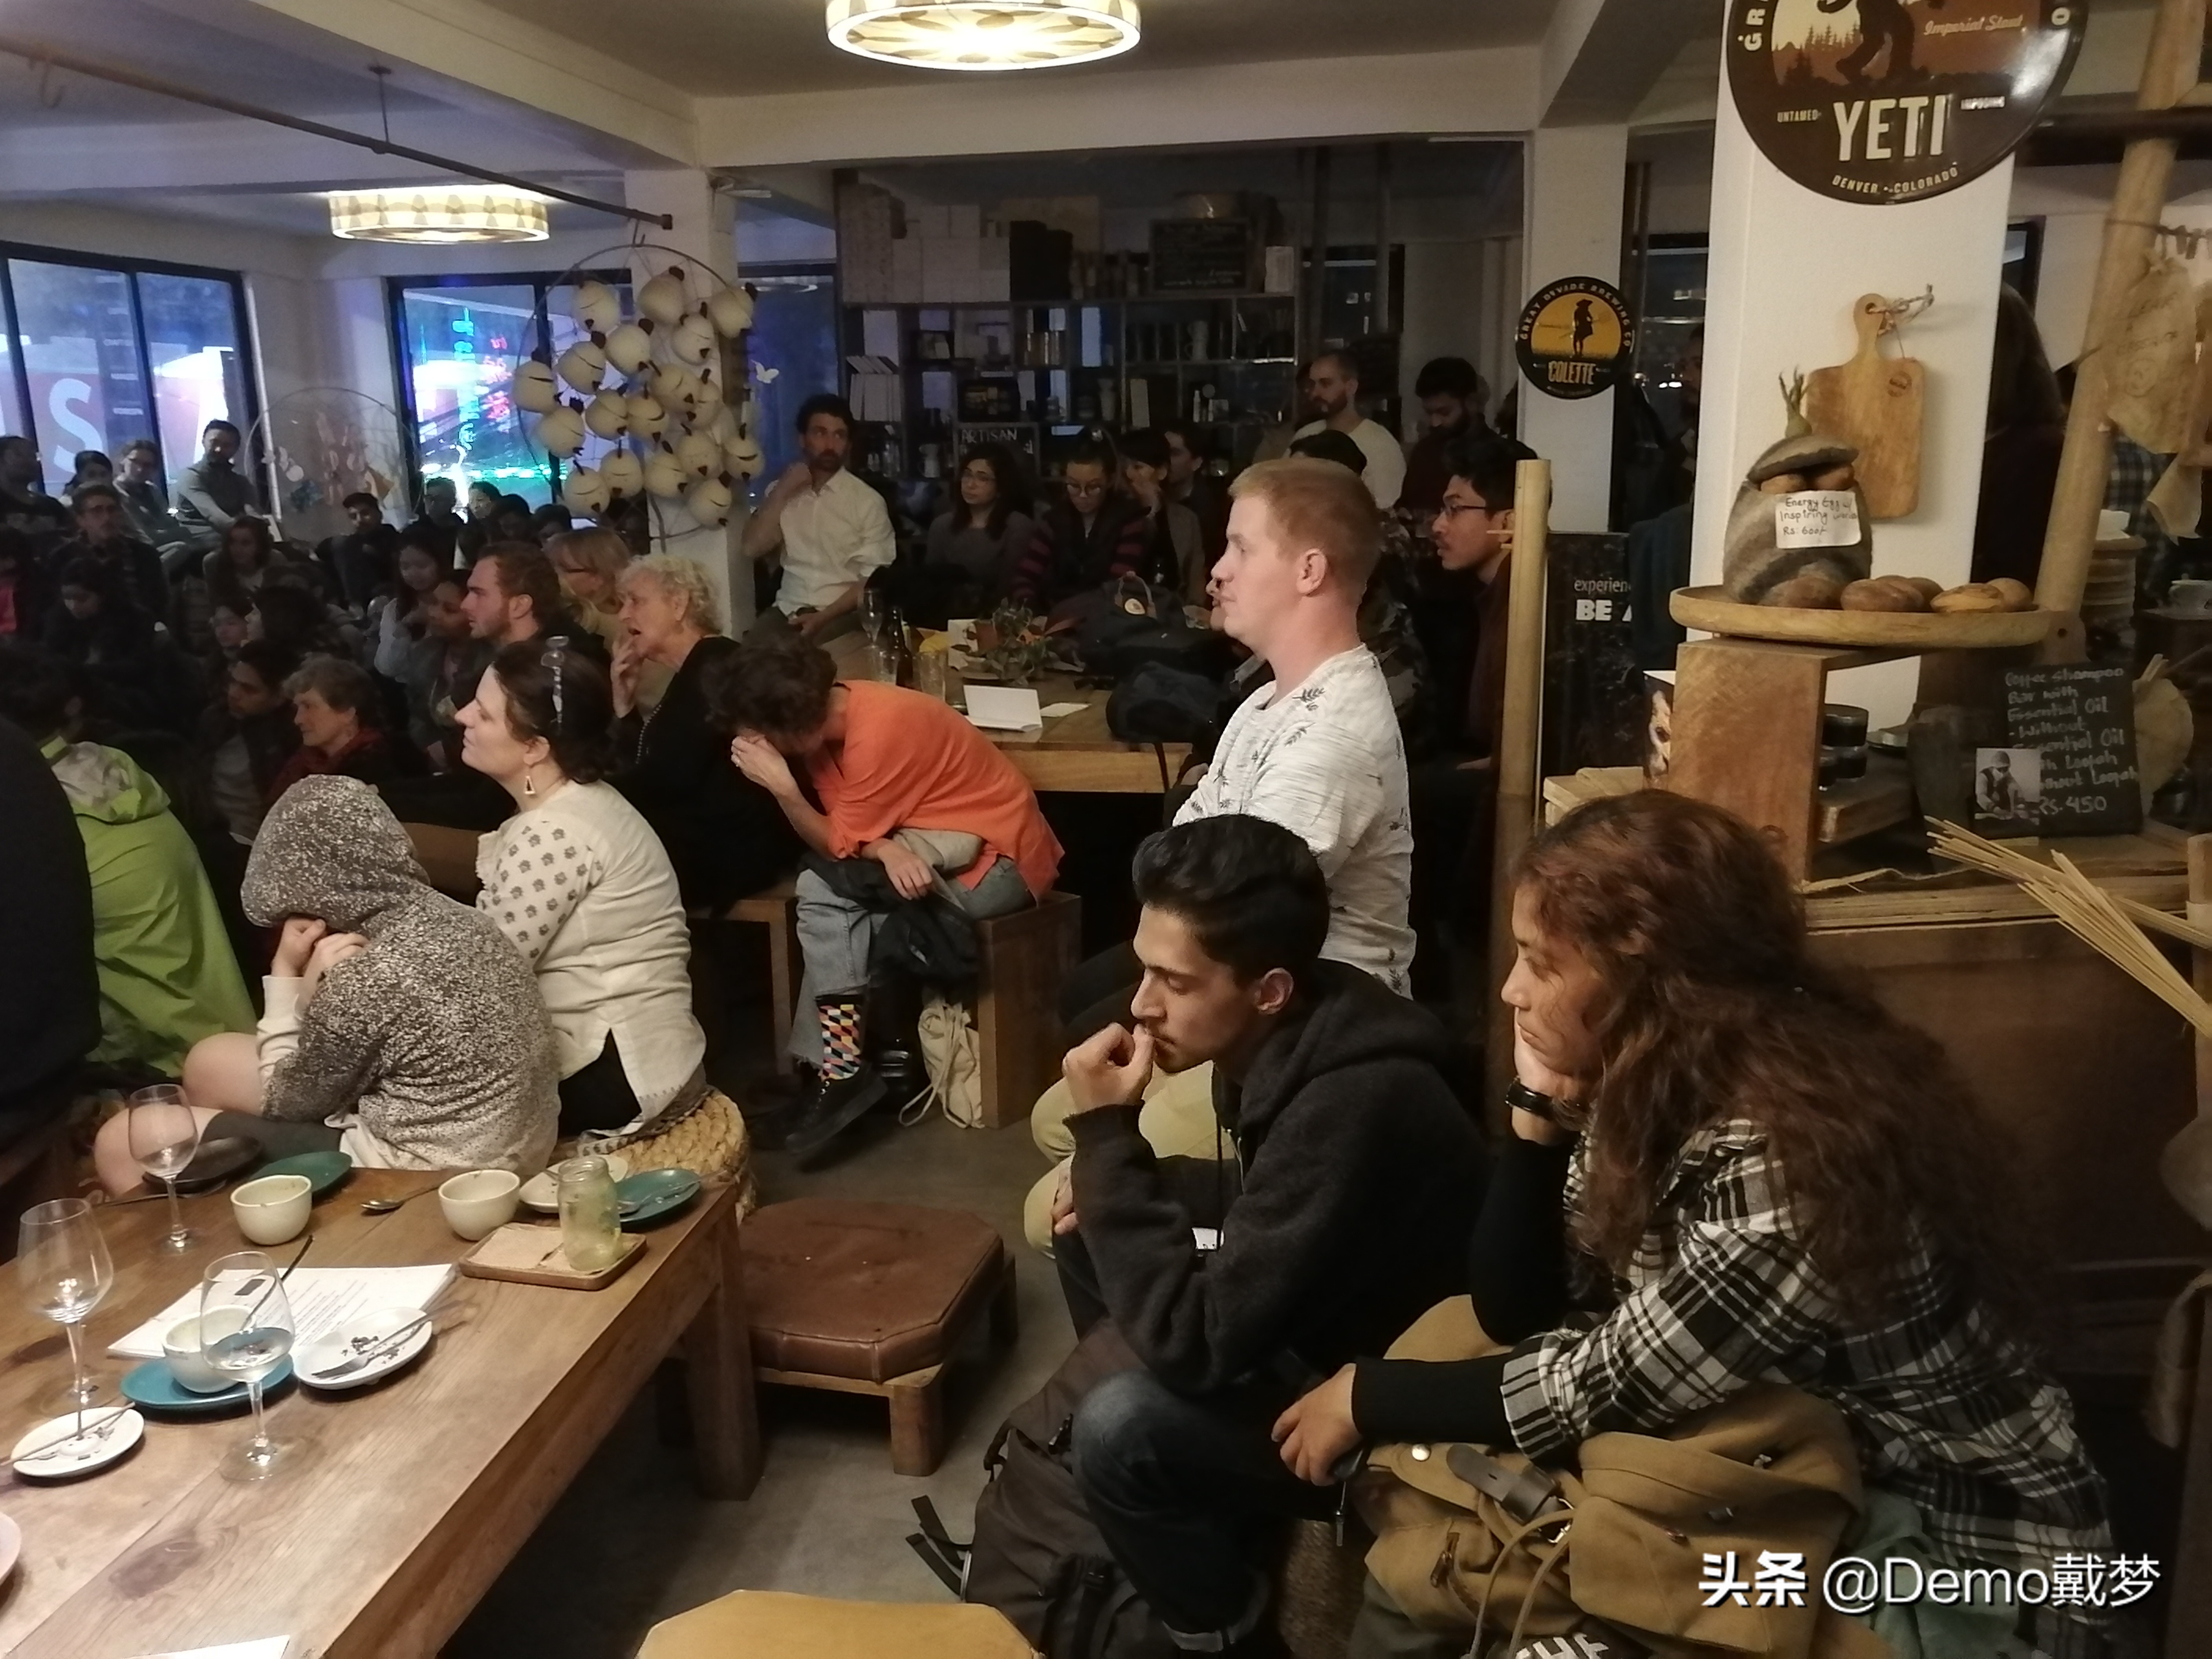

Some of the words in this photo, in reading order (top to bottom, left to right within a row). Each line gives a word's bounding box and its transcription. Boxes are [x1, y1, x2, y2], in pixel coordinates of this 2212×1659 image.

[1833, 94, 1948, 161] YETI
[1832, 174, 1878, 194] DENVER
[1893, 167, 1958, 193] COLORADO
[1548, 360, 1597, 385] COLETTE
[961, 428, 1017, 444] ARTISAN
[1785, 497, 1818, 512] Energy
[1574, 577, 1631, 595] experien
[1576, 599, 1612, 621] BE
[2084, 695, 2109, 714] Oil
[2100, 727, 2125, 746] Oil
[2065, 795, 2108, 814] 450
